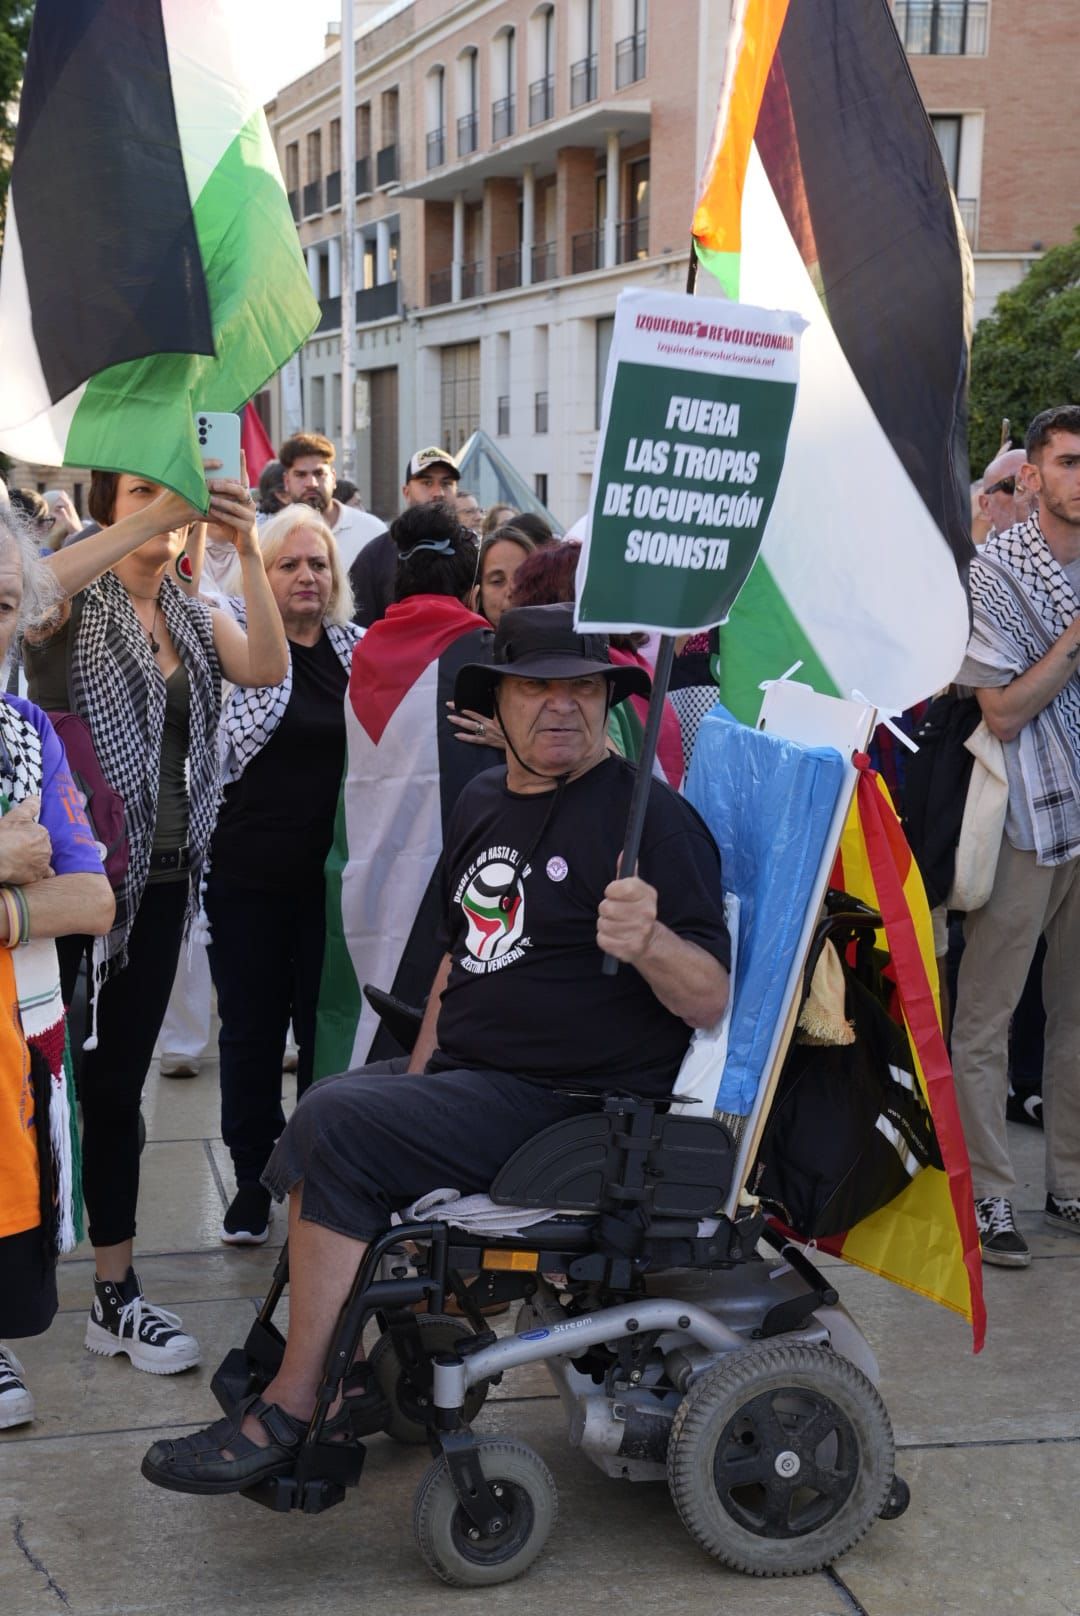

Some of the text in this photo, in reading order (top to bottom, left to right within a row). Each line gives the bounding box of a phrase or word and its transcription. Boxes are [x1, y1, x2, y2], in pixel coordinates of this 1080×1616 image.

[635, 313, 794, 352] IZQUIERDA REVOLUCIONARIA
[657, 341, 775, 368] izquierdarevolucionaria.net
[664, 395, 741, 438] FUERA
[624, 437, 760, 485] LAS TROPAS
[602, 482, 764, 528] DE OCUPACIÓN
[624, 529, 730, 570] SIONISTA
[488, 846, 511, 860] HASTA
[509, 849, 519, 864] EL
[554, 1317, 592, 1333] Stream
